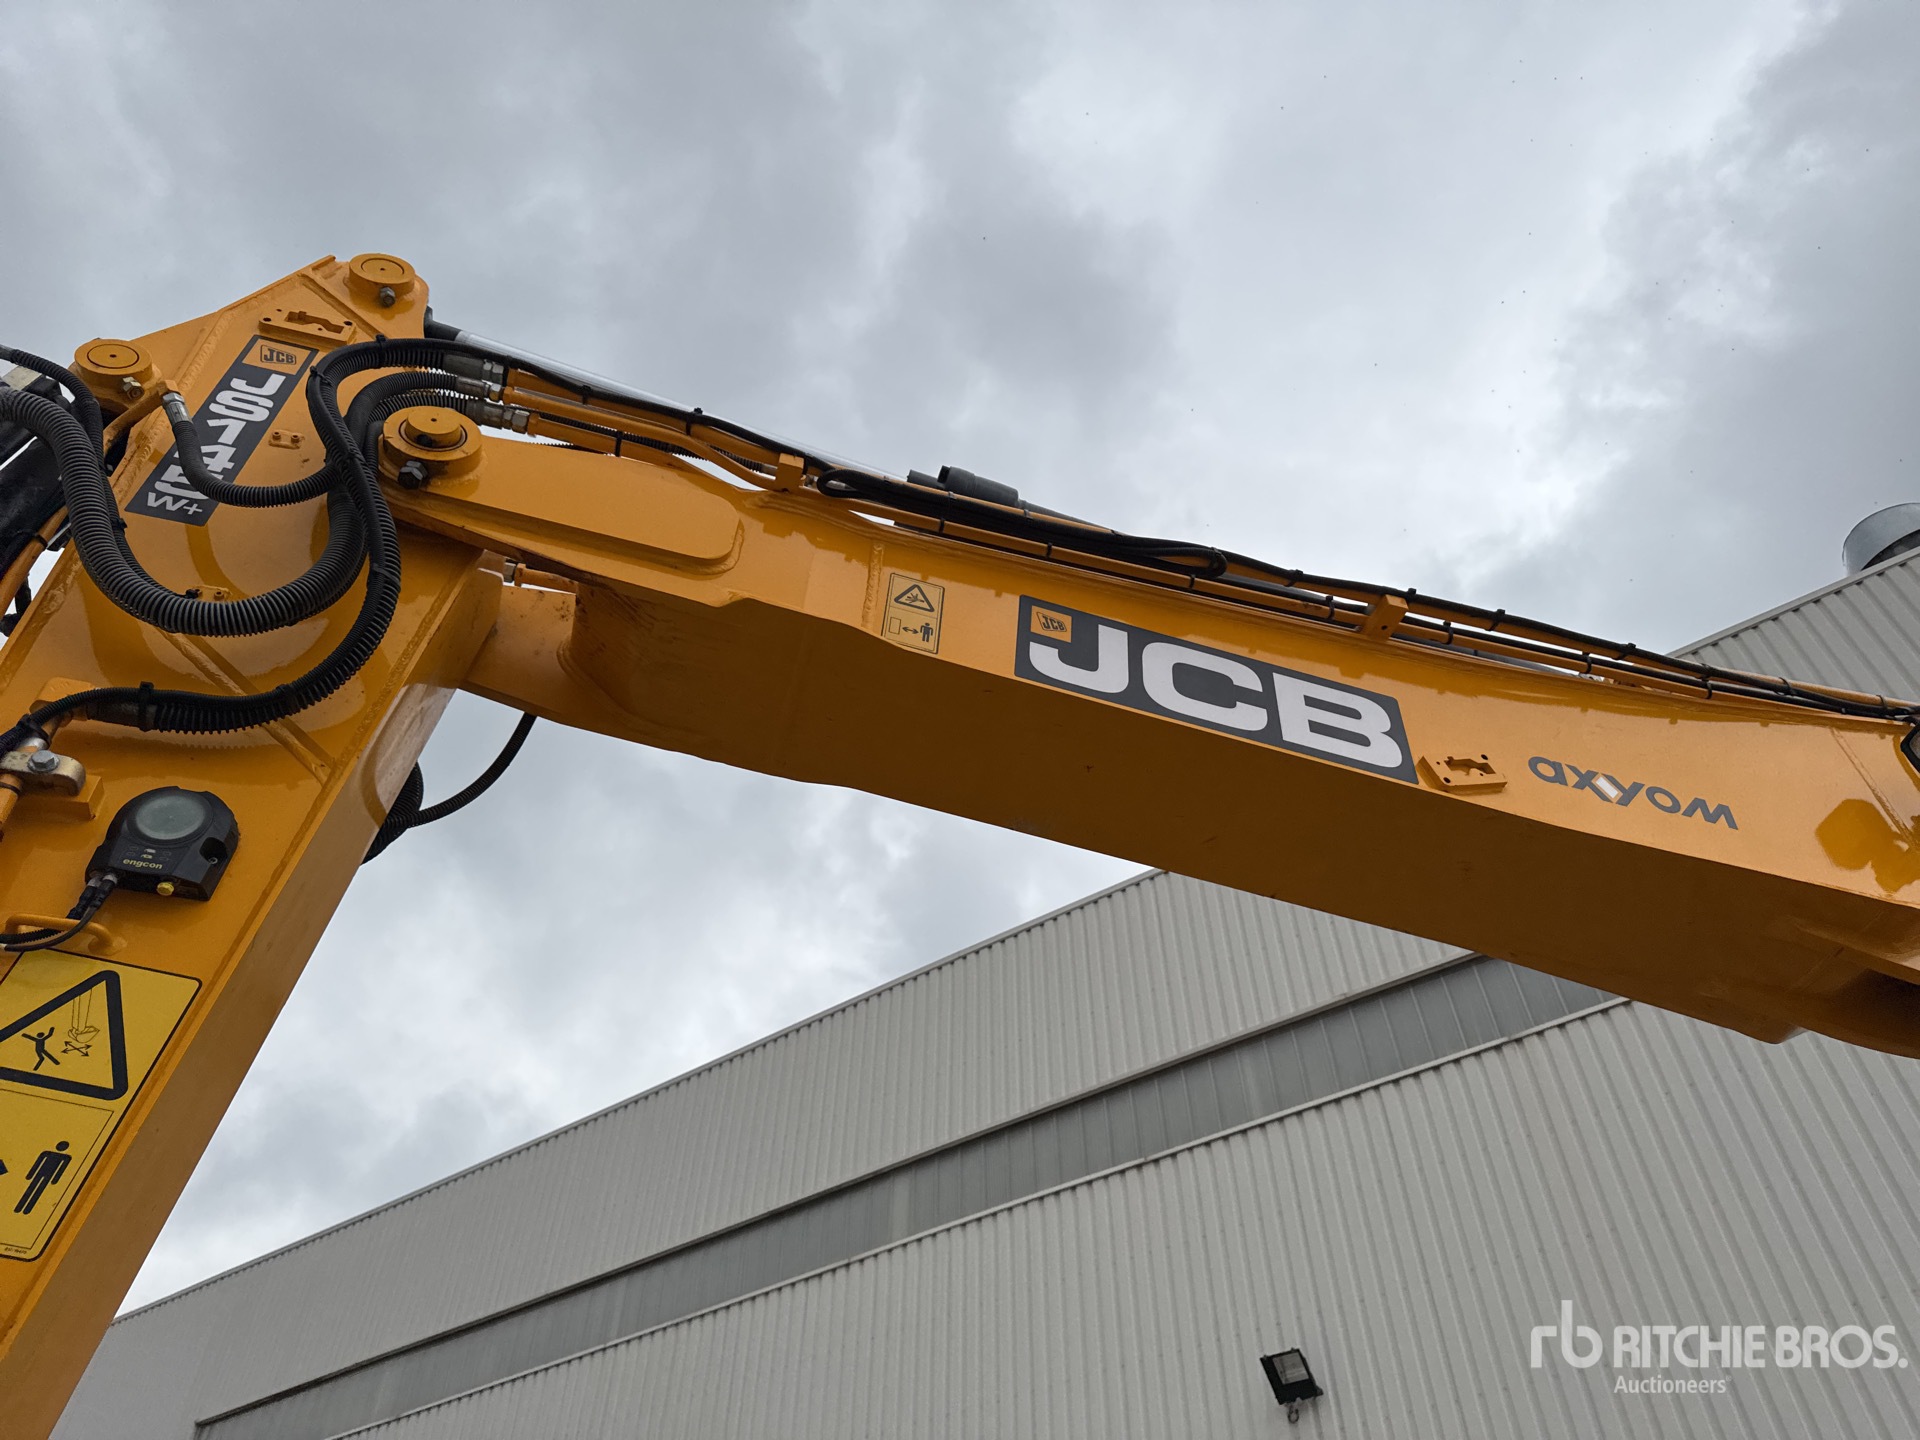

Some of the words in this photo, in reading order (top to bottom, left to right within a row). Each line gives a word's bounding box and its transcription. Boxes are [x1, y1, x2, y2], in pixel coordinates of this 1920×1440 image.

[263, 348, 295, 364] JCB
[146, 491, 203, 515] W+
[1042, 614, 1065, 631] JCB
[1028, 624, 1403, 768] JCB
[122, 858, 163, 870] engcon
